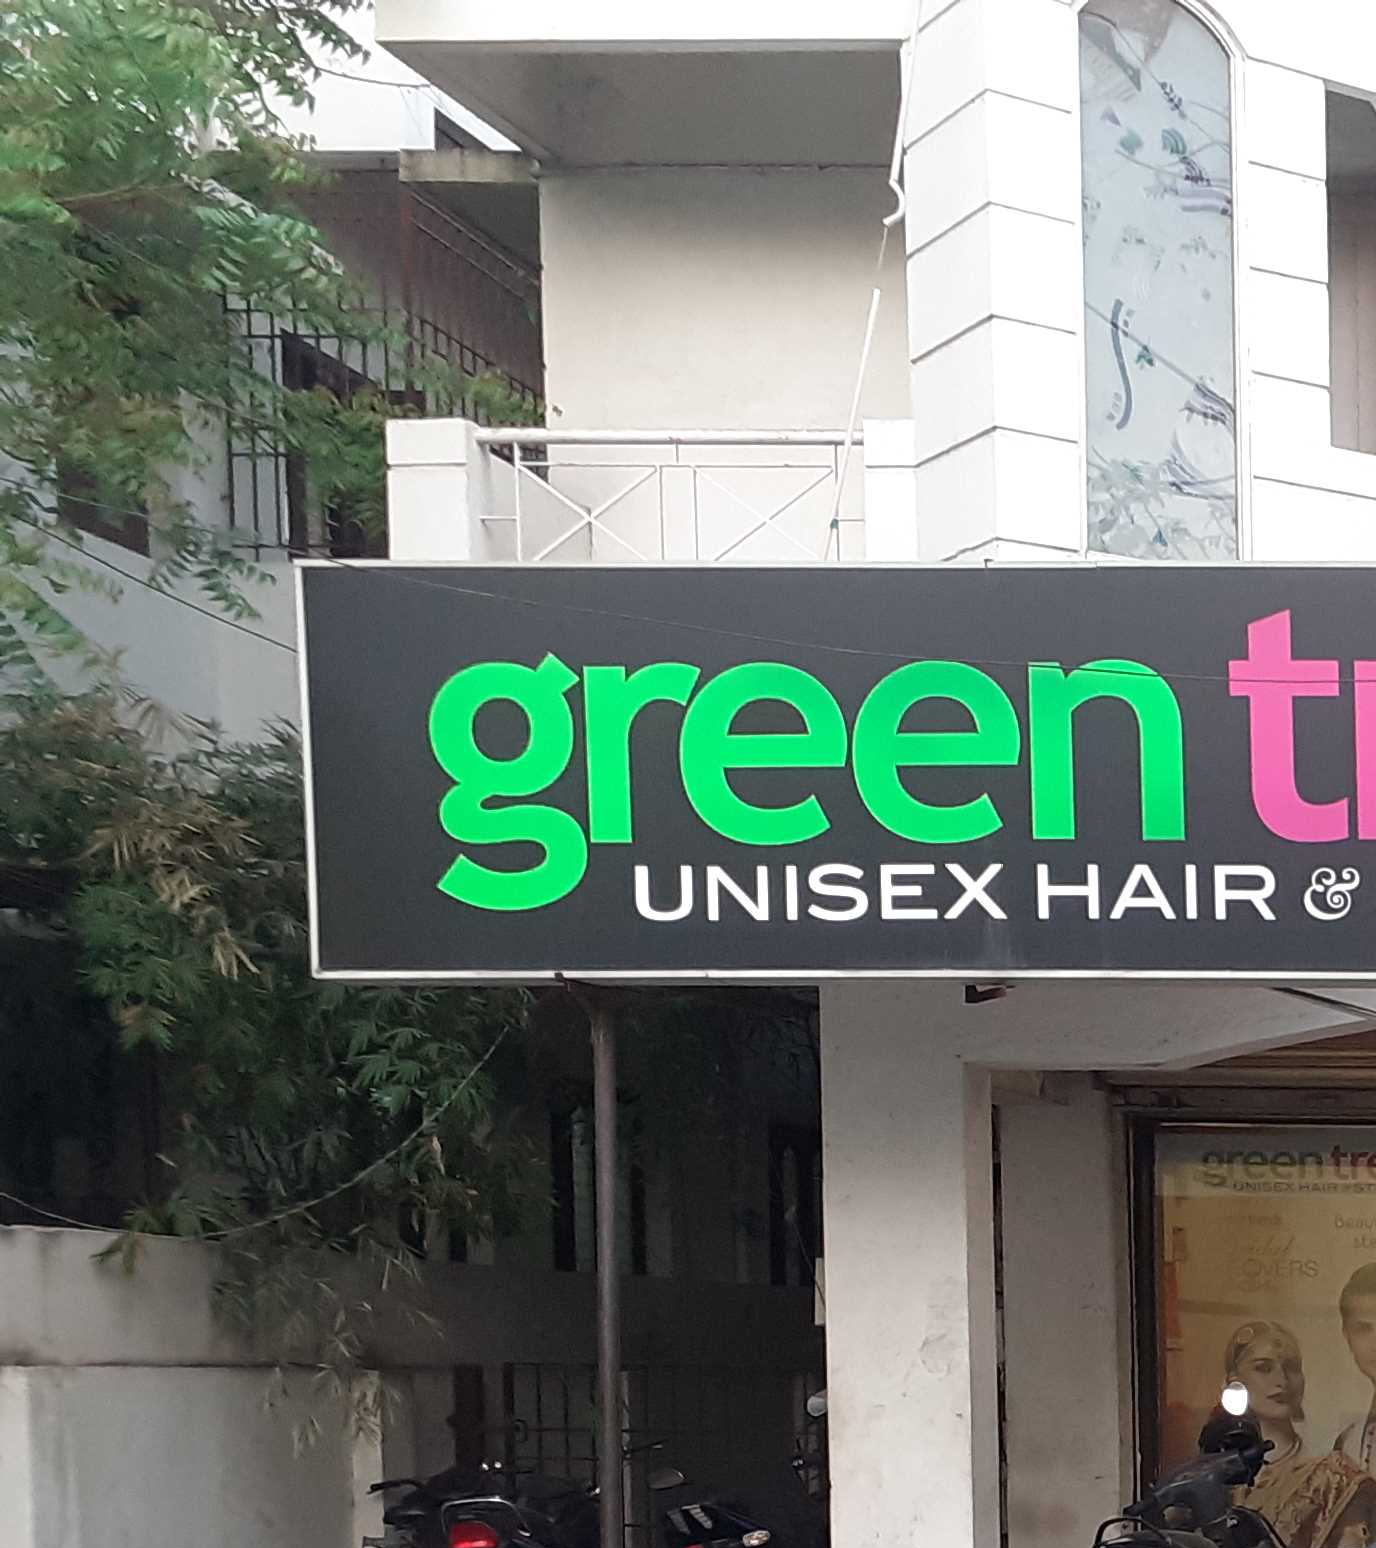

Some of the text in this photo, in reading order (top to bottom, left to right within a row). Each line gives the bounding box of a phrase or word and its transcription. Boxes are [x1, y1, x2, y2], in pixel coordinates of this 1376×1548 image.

[429, 656, 1185, 912] green
[634, 863, 1008, 922] UNISEX
[1036, 863, 1276, 921] HAIR
[1303, 865, 1361, 920] &
[1200, 1148, 1325, 1187] green
